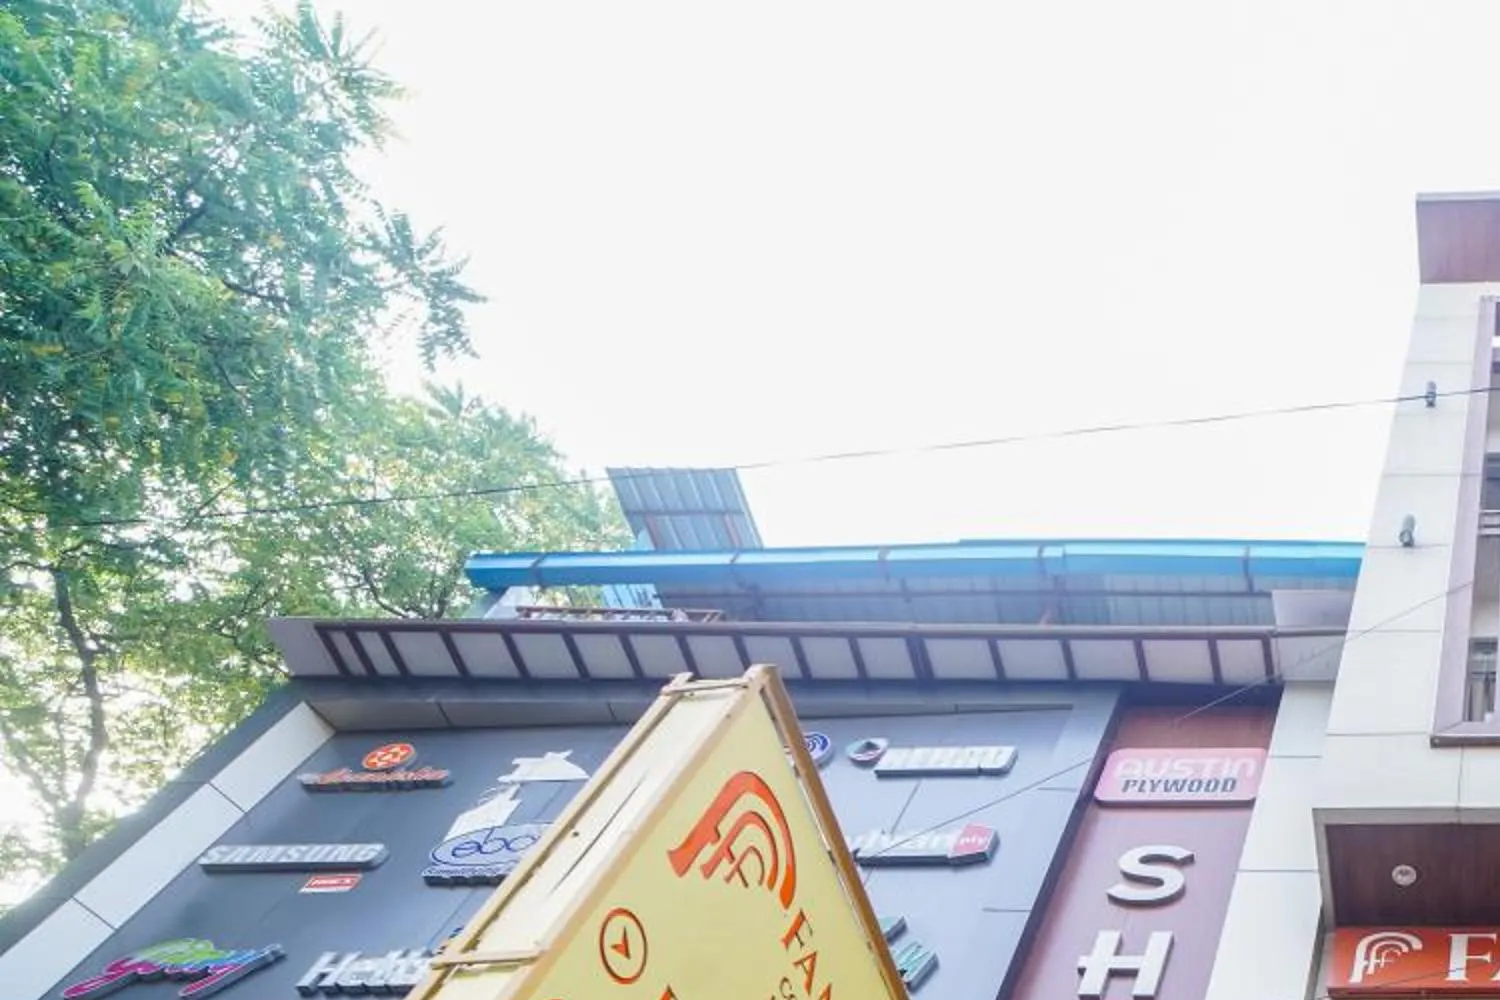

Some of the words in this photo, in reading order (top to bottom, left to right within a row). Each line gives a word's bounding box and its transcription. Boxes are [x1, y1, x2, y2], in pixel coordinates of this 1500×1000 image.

[1113, 757, 1258, 779] AUSTIN
[1121, 776, 1238, 794] PLYWOOD
[199, 843, 385, 866] SAMSUNG
